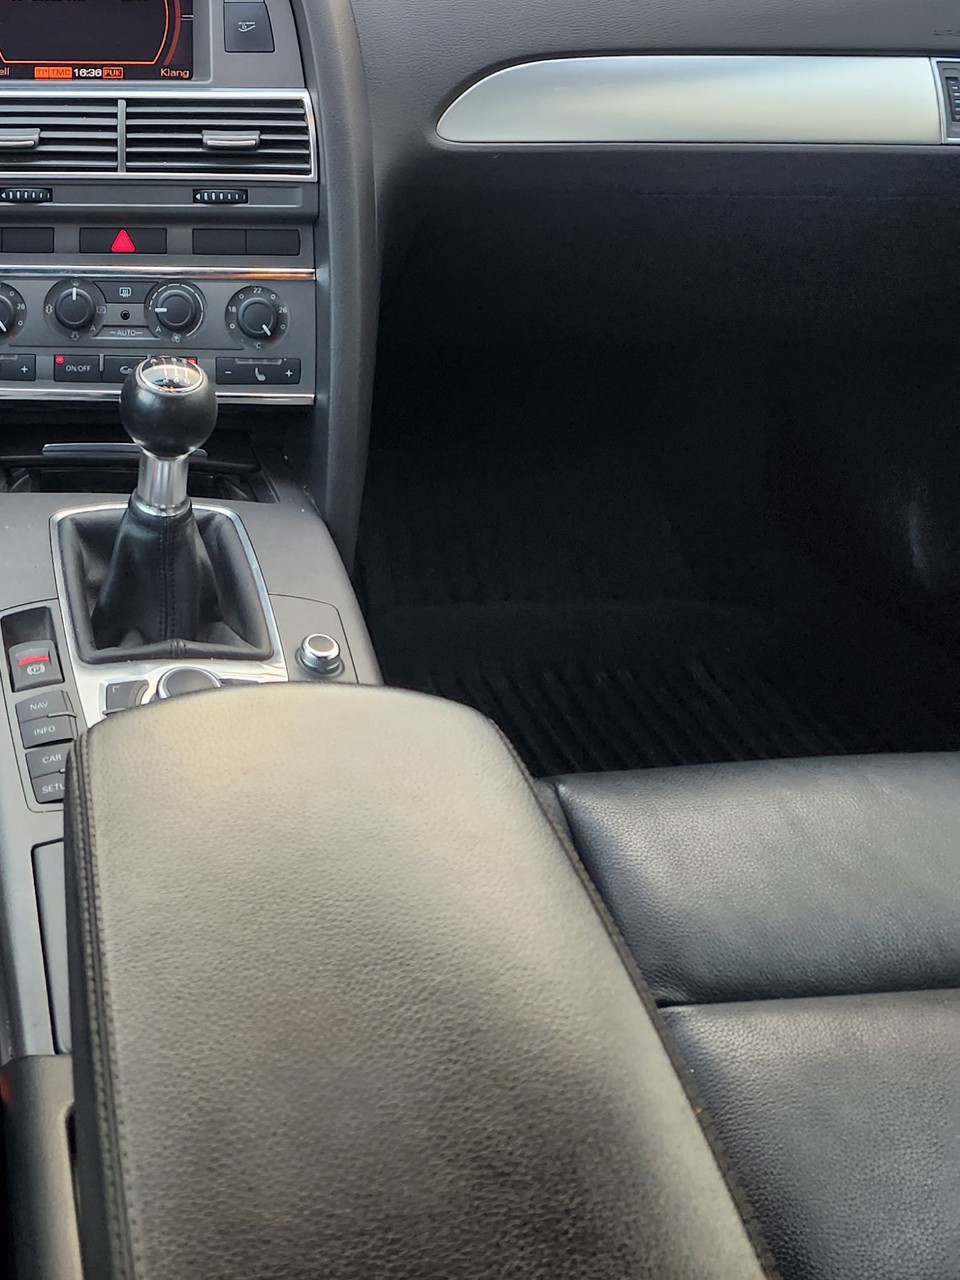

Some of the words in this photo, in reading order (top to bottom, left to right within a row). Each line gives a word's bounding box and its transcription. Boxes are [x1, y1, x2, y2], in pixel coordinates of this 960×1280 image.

[51, 68, 71, 76] TMC
[160, 68, 189, 78] Klang
[278, 306, 288, 314] 26
[29, 700, 49, 711] NAV
[33, 724, 56, 736] INFO
[42, 753, 62, 765] CAR
